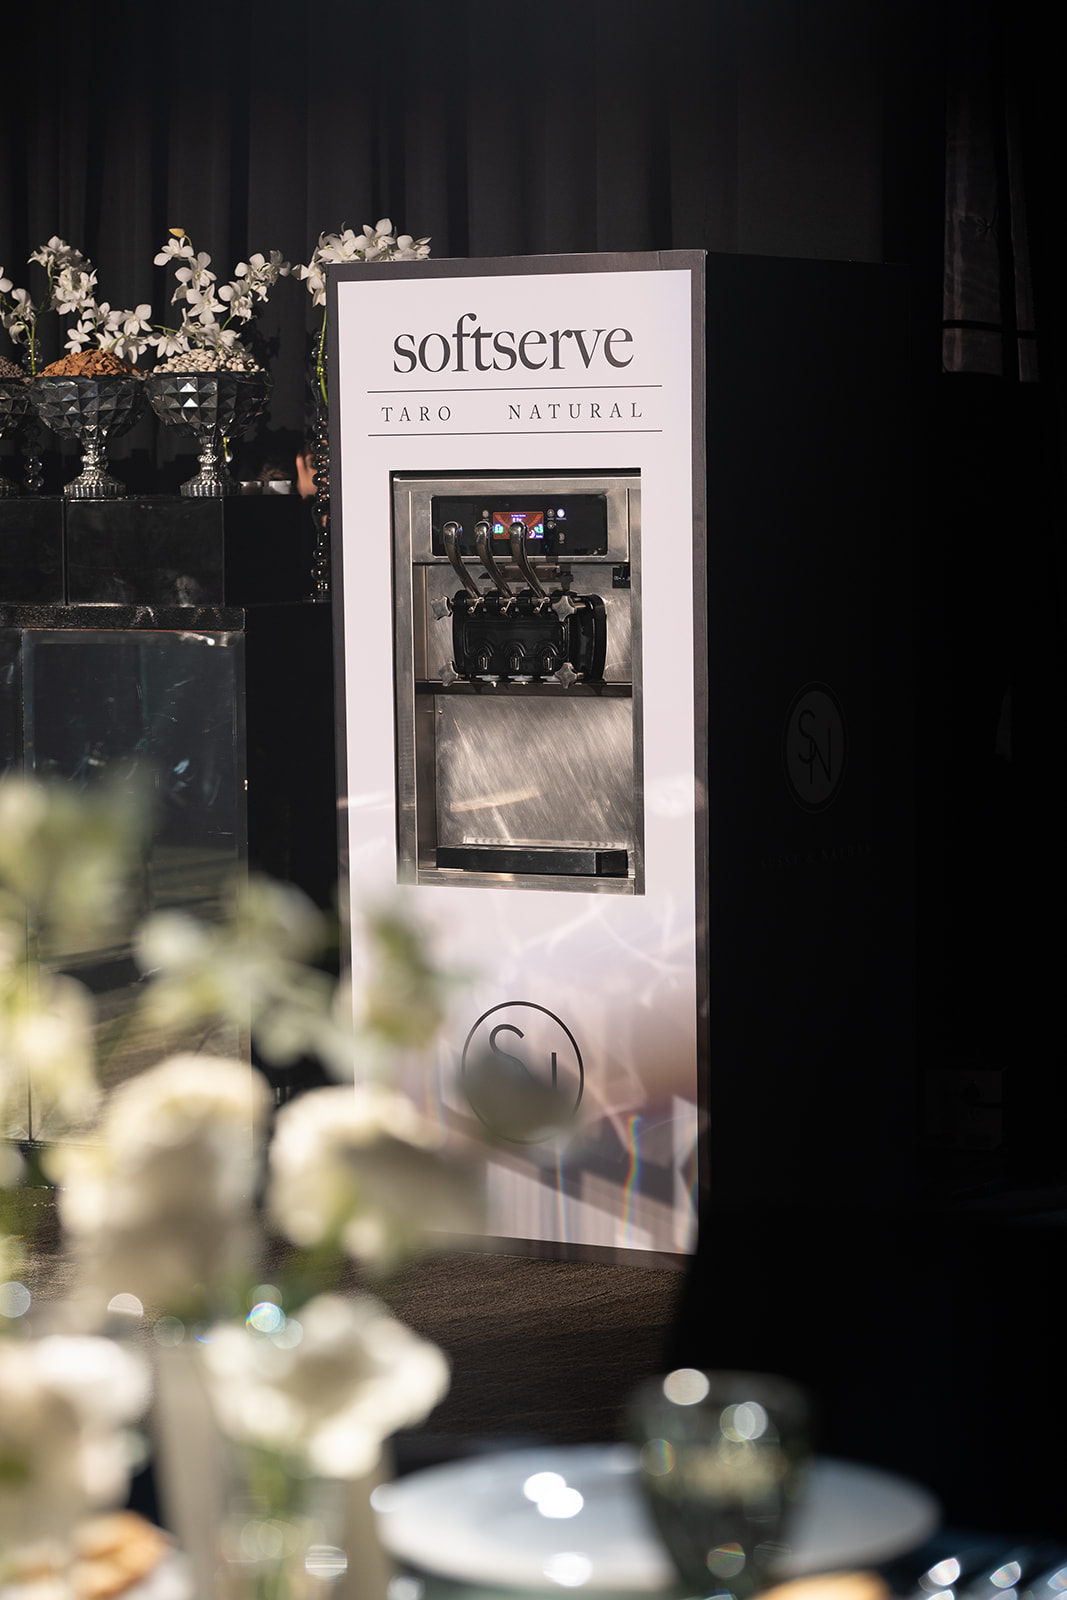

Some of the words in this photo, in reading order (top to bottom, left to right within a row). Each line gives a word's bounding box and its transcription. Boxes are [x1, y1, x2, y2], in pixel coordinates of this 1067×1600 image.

[393, 312, 634, 374] softserve
[381, 405, 452, 423] TARO
[508, 402, 643, 420] NATURAL
